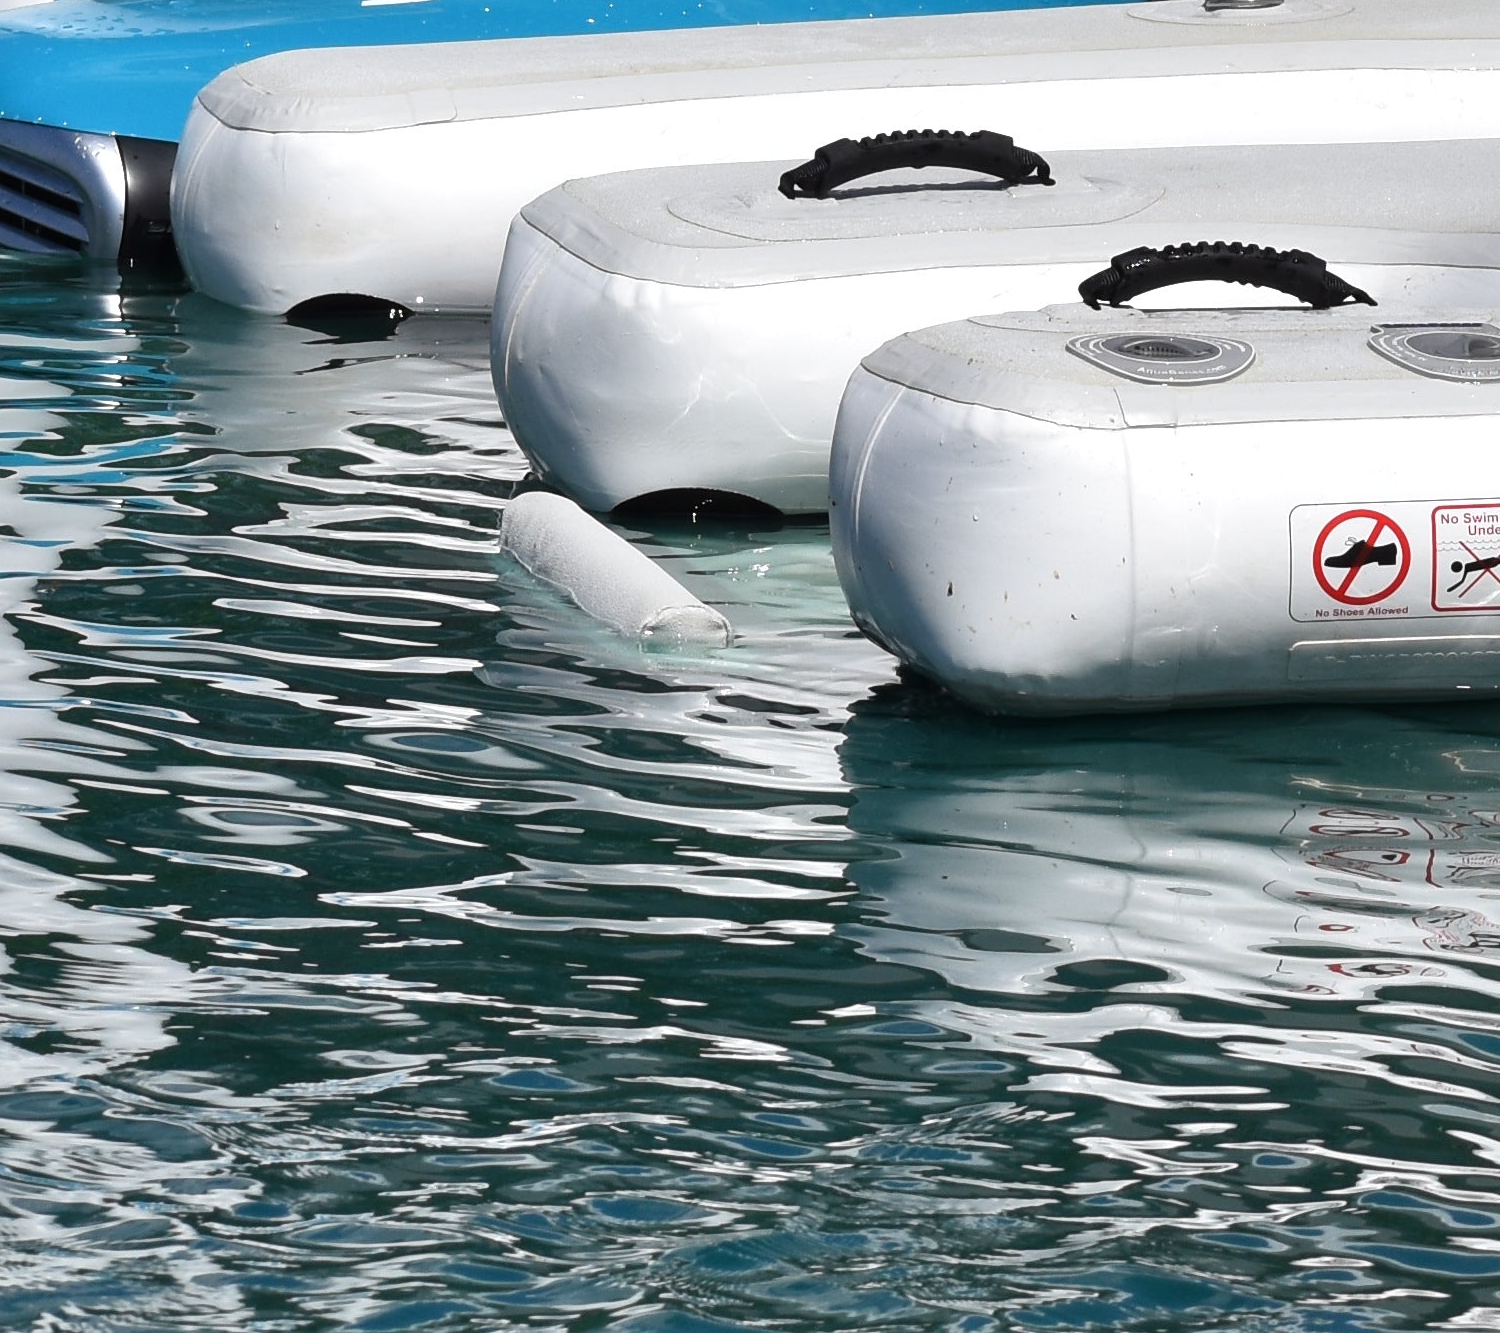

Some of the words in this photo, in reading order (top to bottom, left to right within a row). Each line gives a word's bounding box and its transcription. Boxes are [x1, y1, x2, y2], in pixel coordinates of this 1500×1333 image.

[1440, 513, 1459, 525] No
[1315, 608, 1330, 618] No
[1332, 607, 1365, 618] Shoes
[1367, 605, 1409, 616] Allowed
